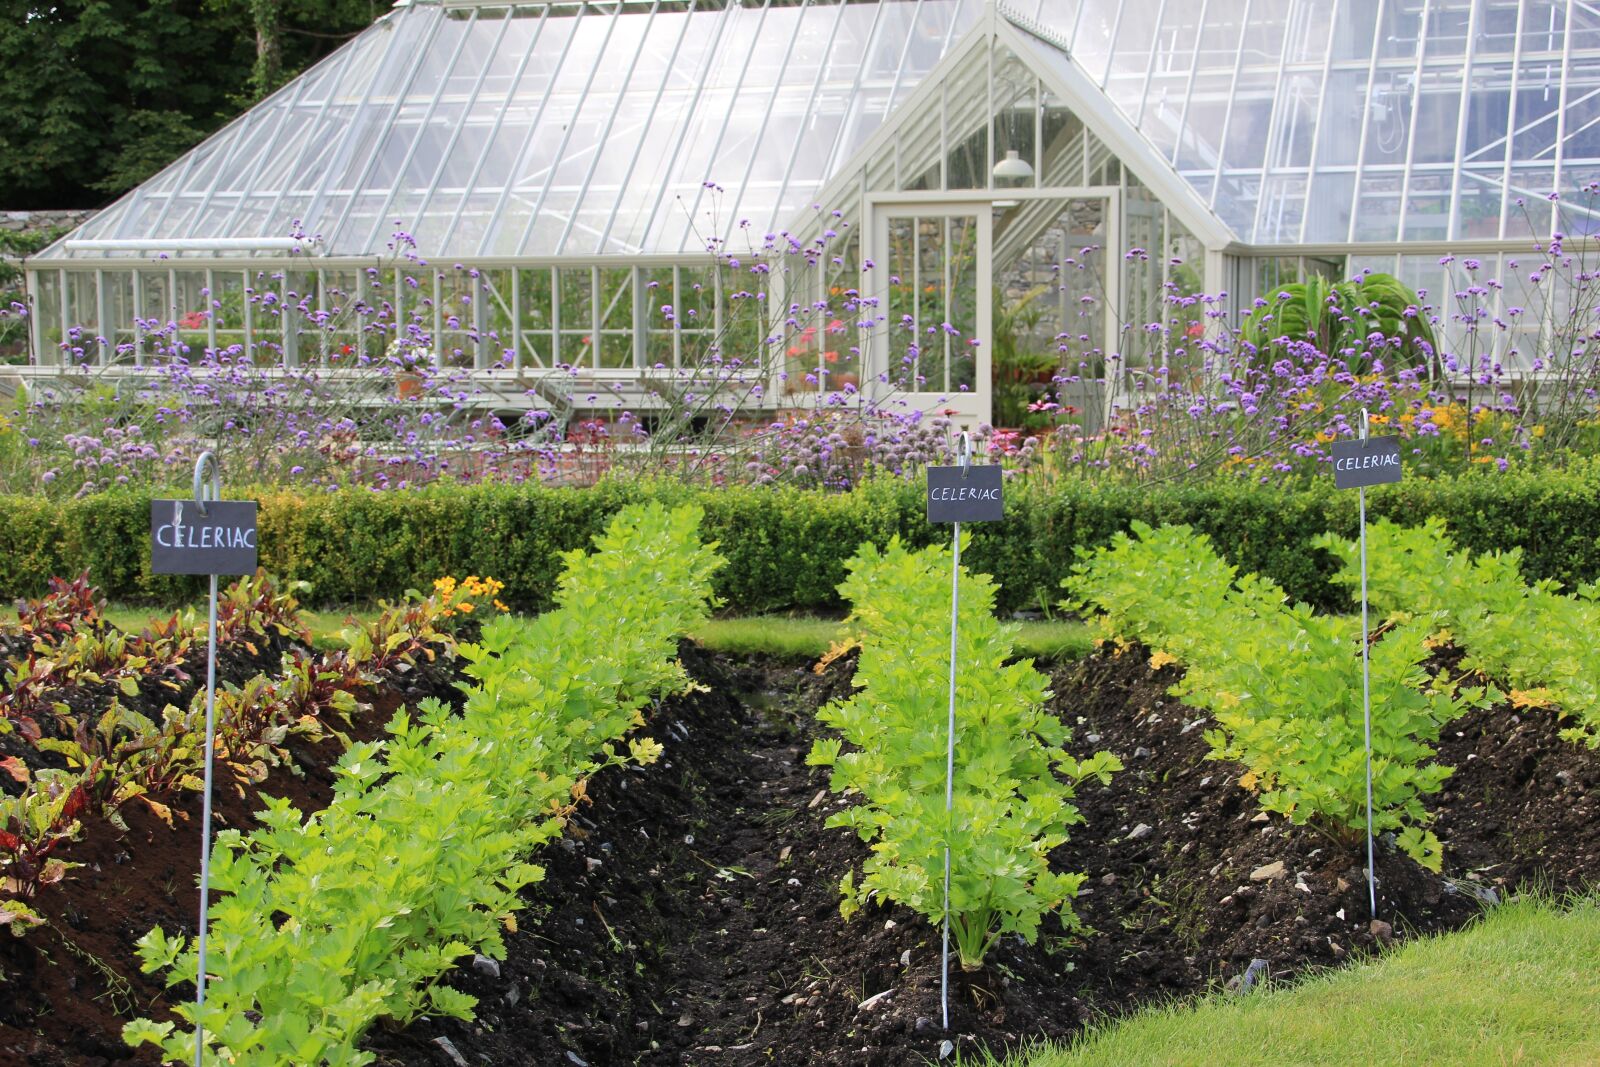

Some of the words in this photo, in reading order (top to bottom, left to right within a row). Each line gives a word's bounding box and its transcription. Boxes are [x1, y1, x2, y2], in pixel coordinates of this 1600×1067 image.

[1336, 453, 1399, 471] CELERIAC
[931, 487, 1000, 501] CELERIAC
[157, 524, 255, 548] CELERIAC
